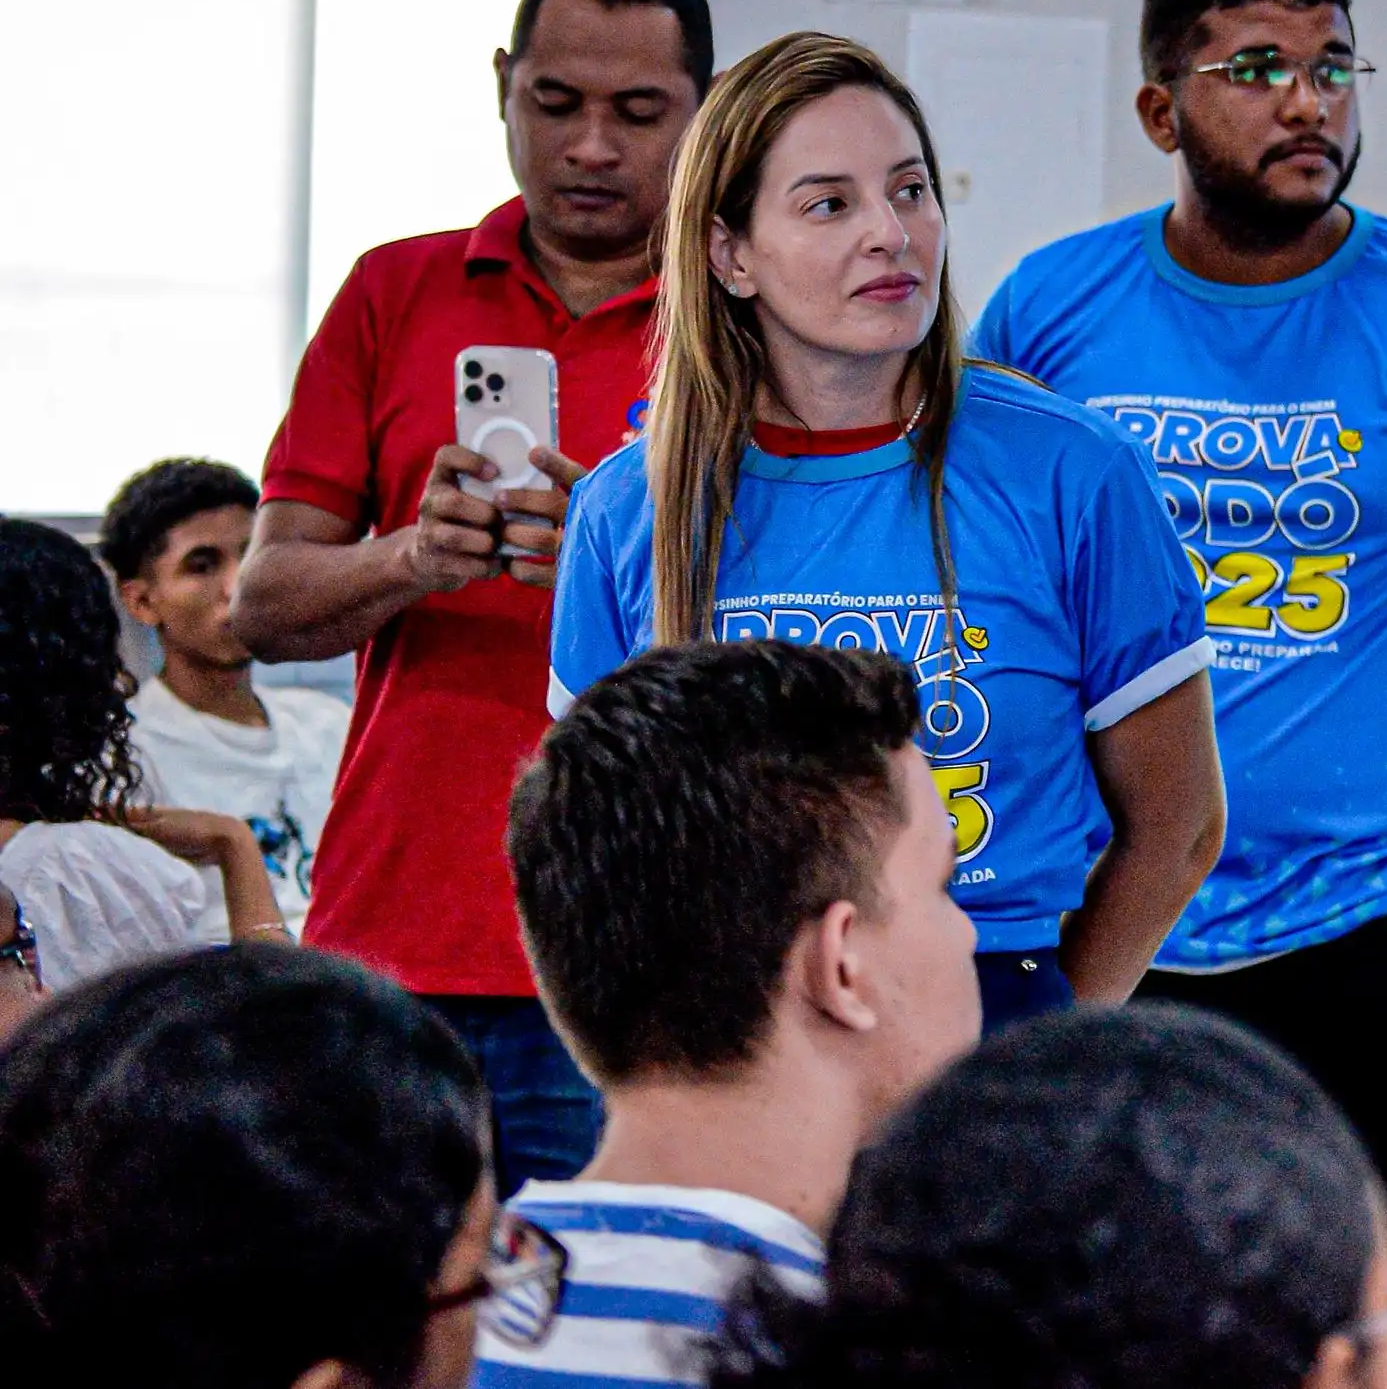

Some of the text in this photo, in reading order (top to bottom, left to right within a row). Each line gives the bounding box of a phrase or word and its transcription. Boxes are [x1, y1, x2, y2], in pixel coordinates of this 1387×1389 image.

[1113, 406, 1357, 471] PROVA
[761, 591, 867, 607] PREPARATÓRIO
[867, 594, 904, 608] PARA
[905, 595, 917, 606] O
